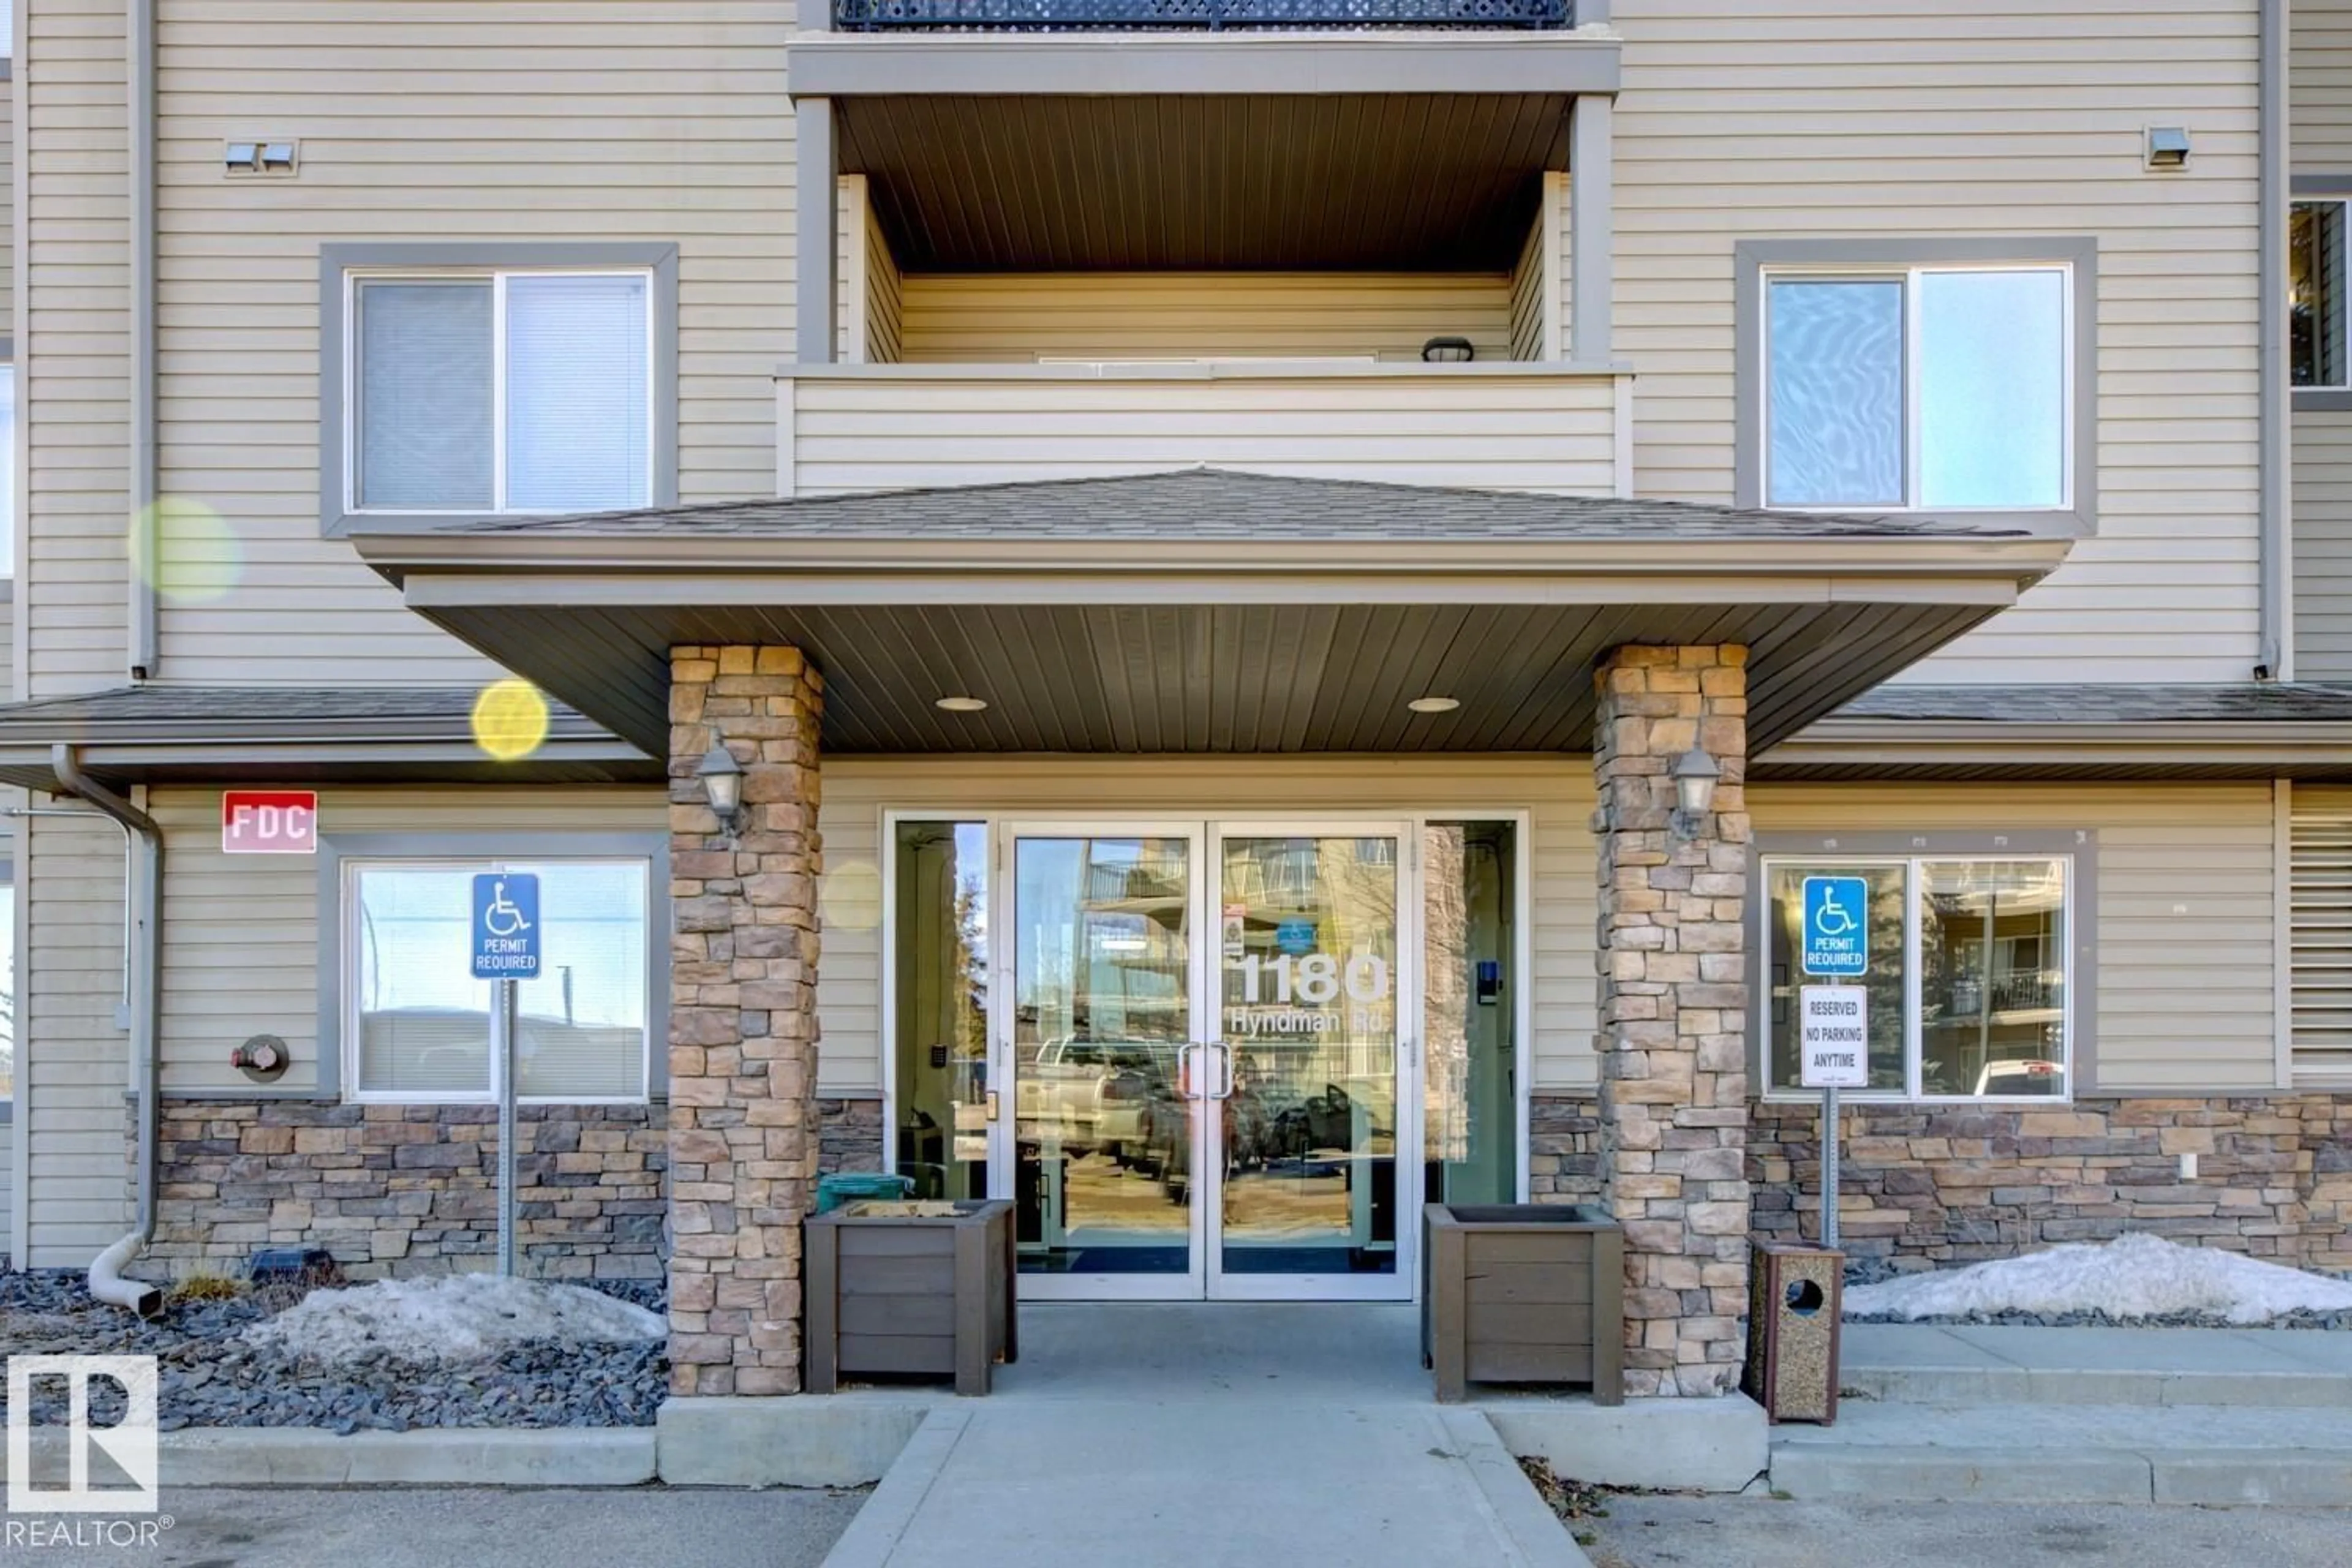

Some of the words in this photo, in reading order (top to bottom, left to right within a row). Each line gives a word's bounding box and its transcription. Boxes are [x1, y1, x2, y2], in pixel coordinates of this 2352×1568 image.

[232, 804, 306, 839] FDC
[484, 939, 527, 953] PERMIT
[1815, 937, 1854, 951] PERMIT
[477, 955, 536, 970] REQUIRED
[1807, 952, 1863, 965] REQUIRED
[1230, 954, 1389, 1003] 1180
[1809, 1001, 1858, 1016] RESERVED
[1231, 1009, 1340, 1038] Hyndman
[1806, 1027, 1820, 1041] NO
[1821, 1027, 1863, 1042] PARKING
[1814, 1054, 1855, 1067] ANYTIME
